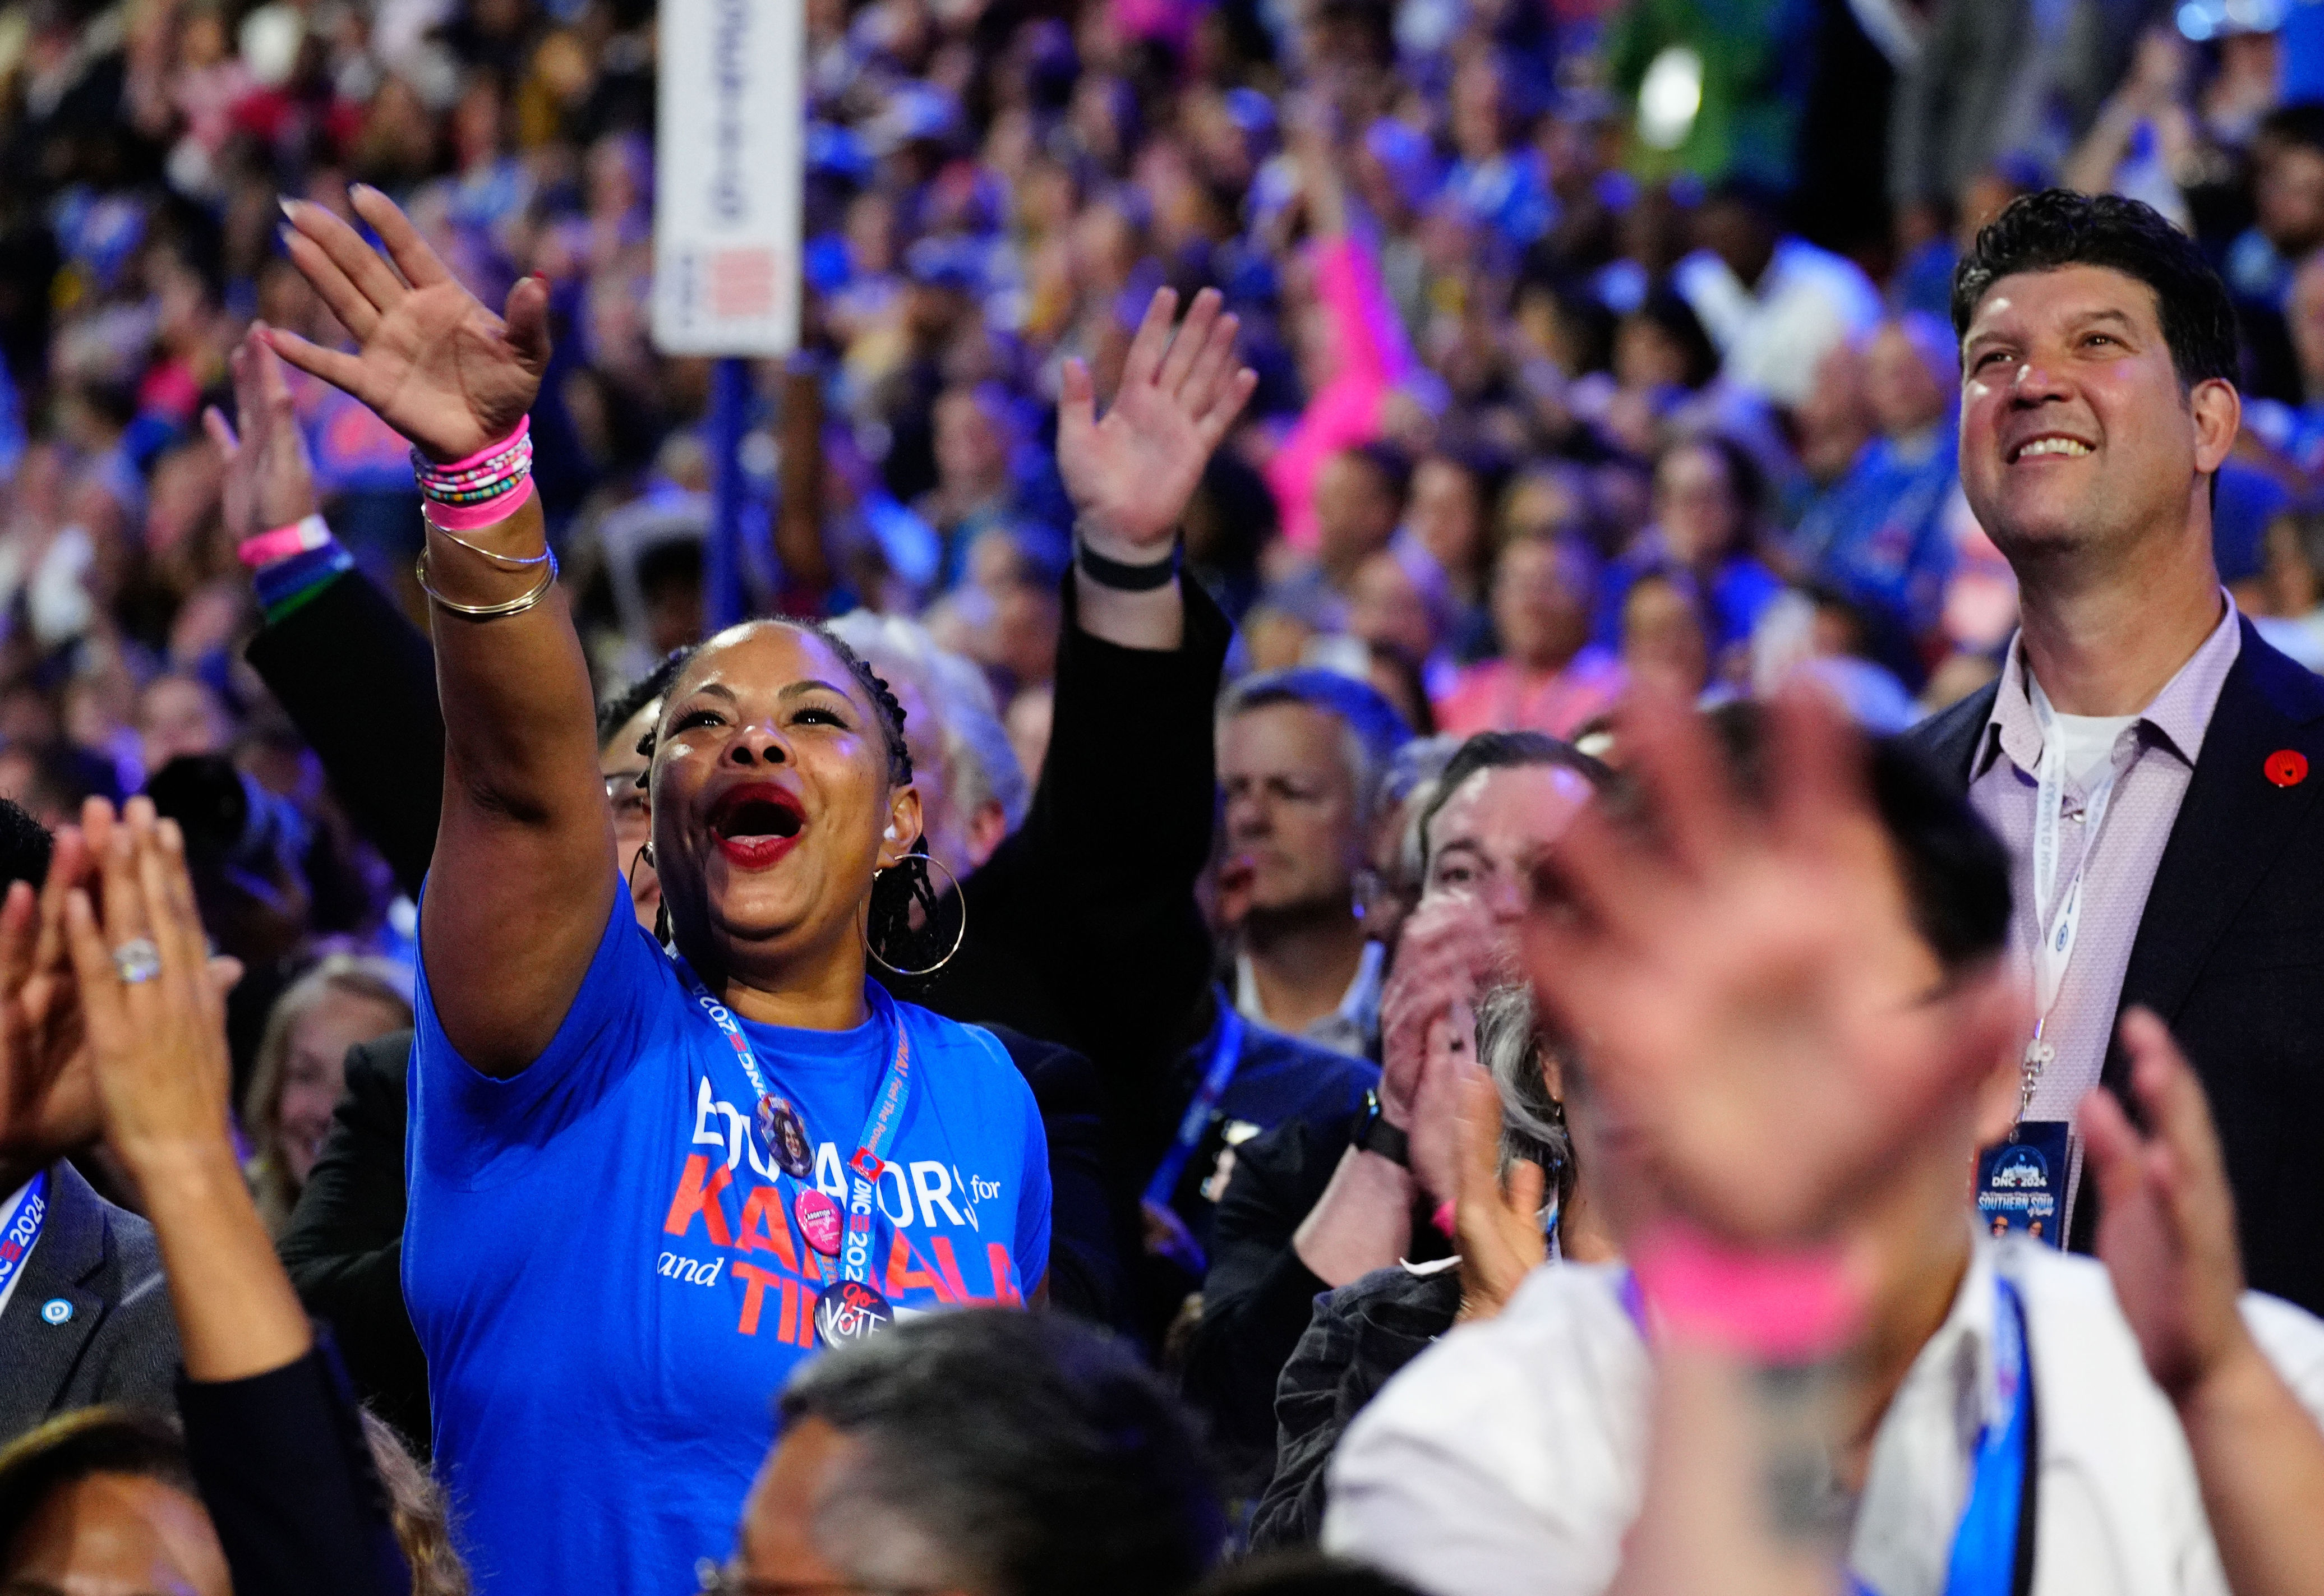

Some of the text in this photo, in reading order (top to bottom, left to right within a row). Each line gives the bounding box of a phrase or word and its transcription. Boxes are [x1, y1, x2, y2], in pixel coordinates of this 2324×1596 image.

[888, 1076, 903, 1103] Feel
[878, 1100, 895, 1123] The
[868, 1122, 887, 1154] Powe
[692, 1076, 1000, 1233] EDUAOR for
[851, 1177, 872, 1215] DNC
[1992, 1176, 2047, 1187] DNC 2024
[806, 1208, 831, 1221] ABORTION
[1979, 1196, 2029, 1210] SOUTHERN
[10, 1194, 45, 1247] 2024
[664, 1153, 1023, 1309] KAAL
[657, 1252, 725, 1286] and
[845, 1231, 868, 1281] 202
[50, 1306, 64, 1317] D
